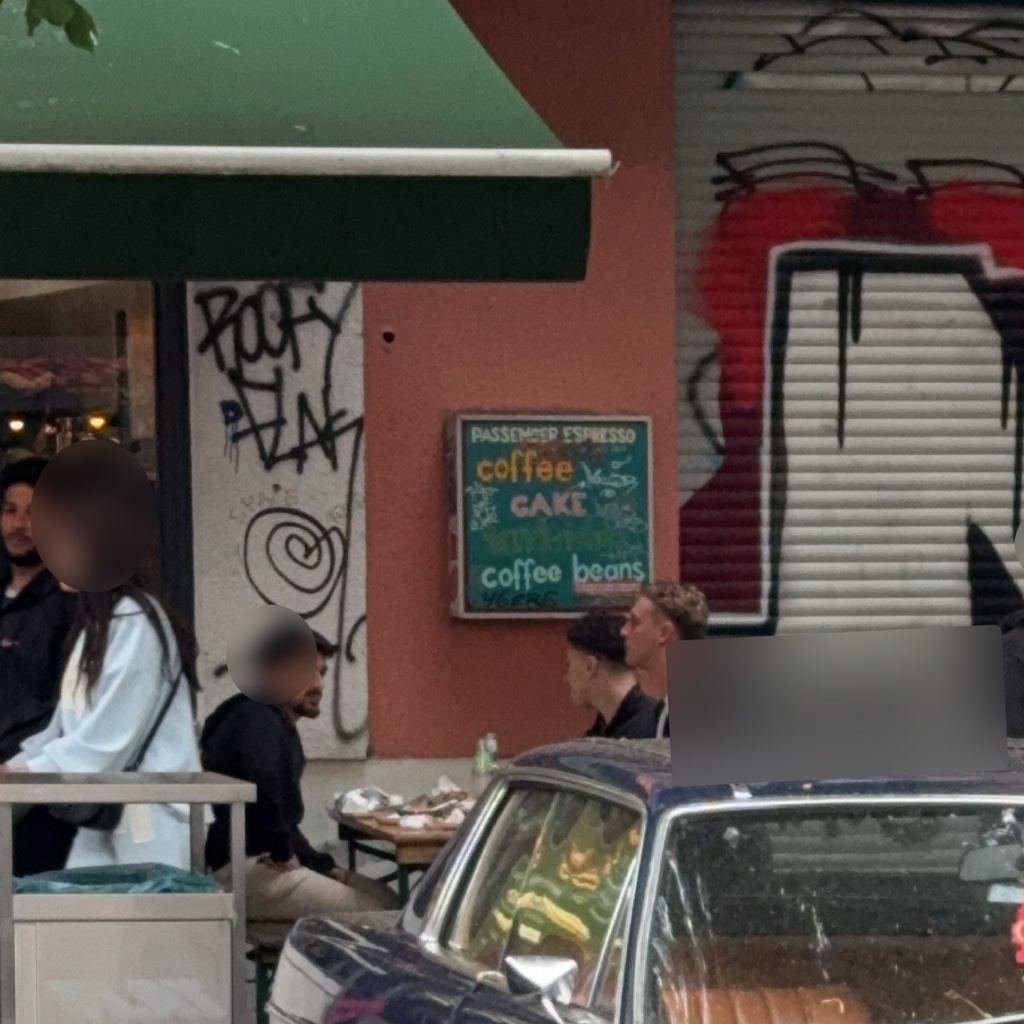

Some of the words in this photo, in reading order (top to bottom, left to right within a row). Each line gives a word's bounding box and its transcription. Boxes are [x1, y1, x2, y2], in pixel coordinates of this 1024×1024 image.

[471, 426, 559, 443] PASSENGER
[563, 426, 636, 443] ESPRESSO
[477, 449, 573, 483] coffee
[510, 491, 587, 518] CAKE
[481, 558, 562, 591] coffee
[572, 553, 646, 583] beans
